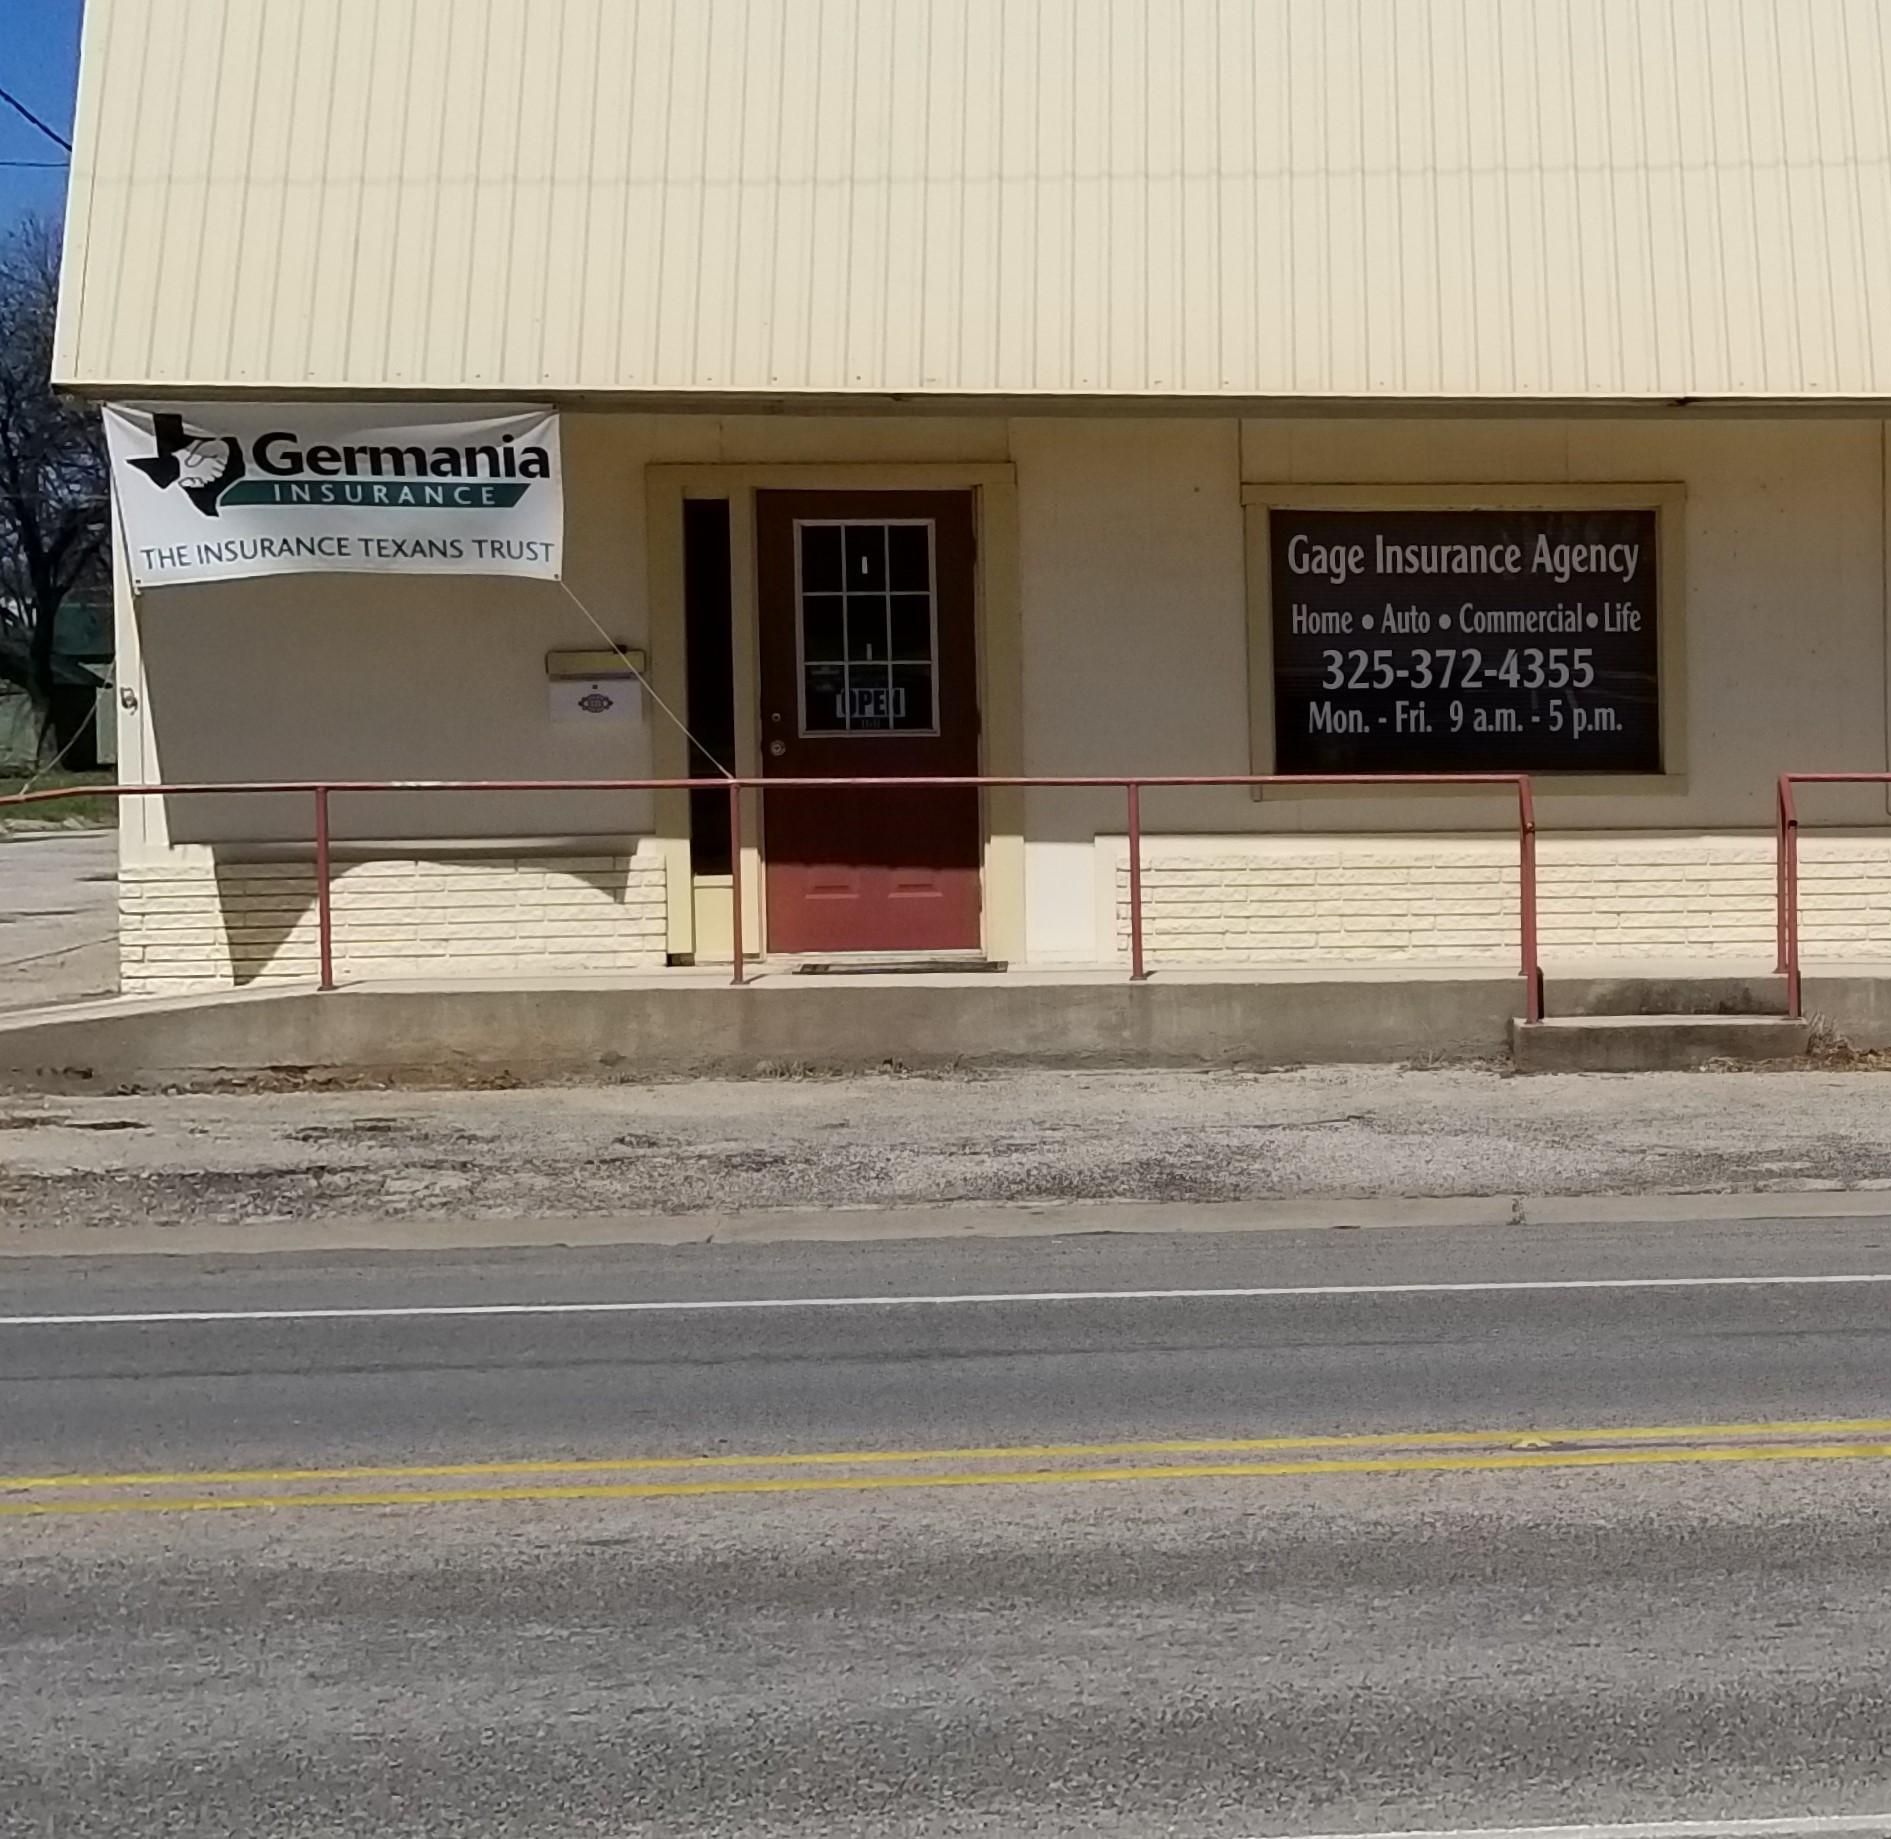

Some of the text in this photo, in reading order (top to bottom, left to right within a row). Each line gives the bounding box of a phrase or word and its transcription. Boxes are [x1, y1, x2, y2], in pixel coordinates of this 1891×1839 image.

[252, 432, 550, 479] Germania
[274, 484, 496, 505] INSURANCE
[142, 538, 555, 570] THE INSURANCE TEXANS TRUST
[1288, 533, 1639, 584] Gage Insurance Agency
[1292, 602, 1642, 634] Home Auto Commercial Life
[1322, 648, 1594, 689] 325-372-4355
[841, 690, 902, 716] OPEN
[1309, 701, 1370, 734] Mon.
[1395, 701, 1433, 733] Fri.
[1449, 701, 1464, 733] 9
[1473, 707, 1524, 733] a.m.
[1549, 700, 1562, 732] 5
[1573, 706, 1623, 739] p.m.
